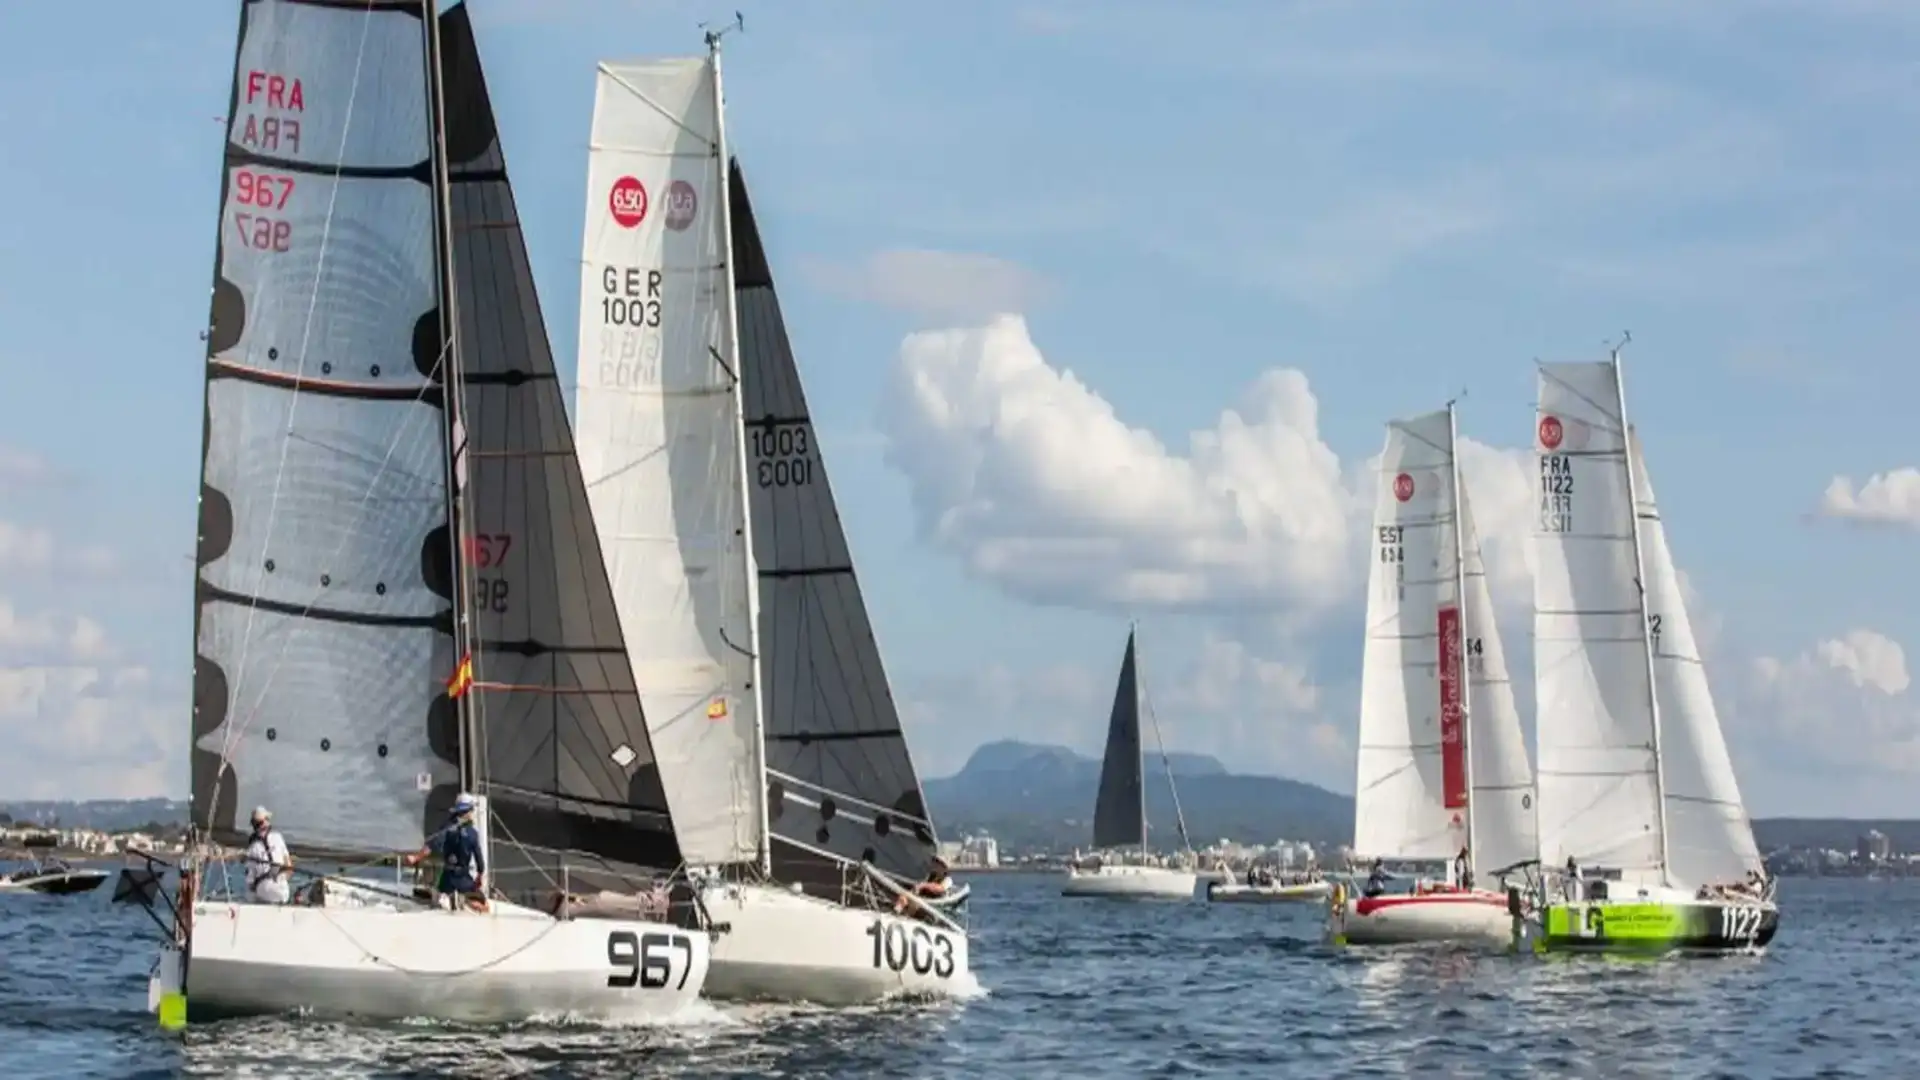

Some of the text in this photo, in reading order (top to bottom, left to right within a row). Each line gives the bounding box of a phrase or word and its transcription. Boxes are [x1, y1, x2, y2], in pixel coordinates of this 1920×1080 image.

[247, 71, 304, 113] FRA
[237, 171, 295, 210] 967
[603, 265, 662, 298] GER
[602, 296, 661, 328] 1003
[752, 426, 808, 457] 1003
[1541, 456, 1571, 474] FRA
[1541, 476, 1574, 494] 1122
[1380, 526, 1404, 544] EST
[1722, 905, 1762, 940] 1122
[607, 931, 692, 991] 967
[866, 919, 954, 979] 1003
